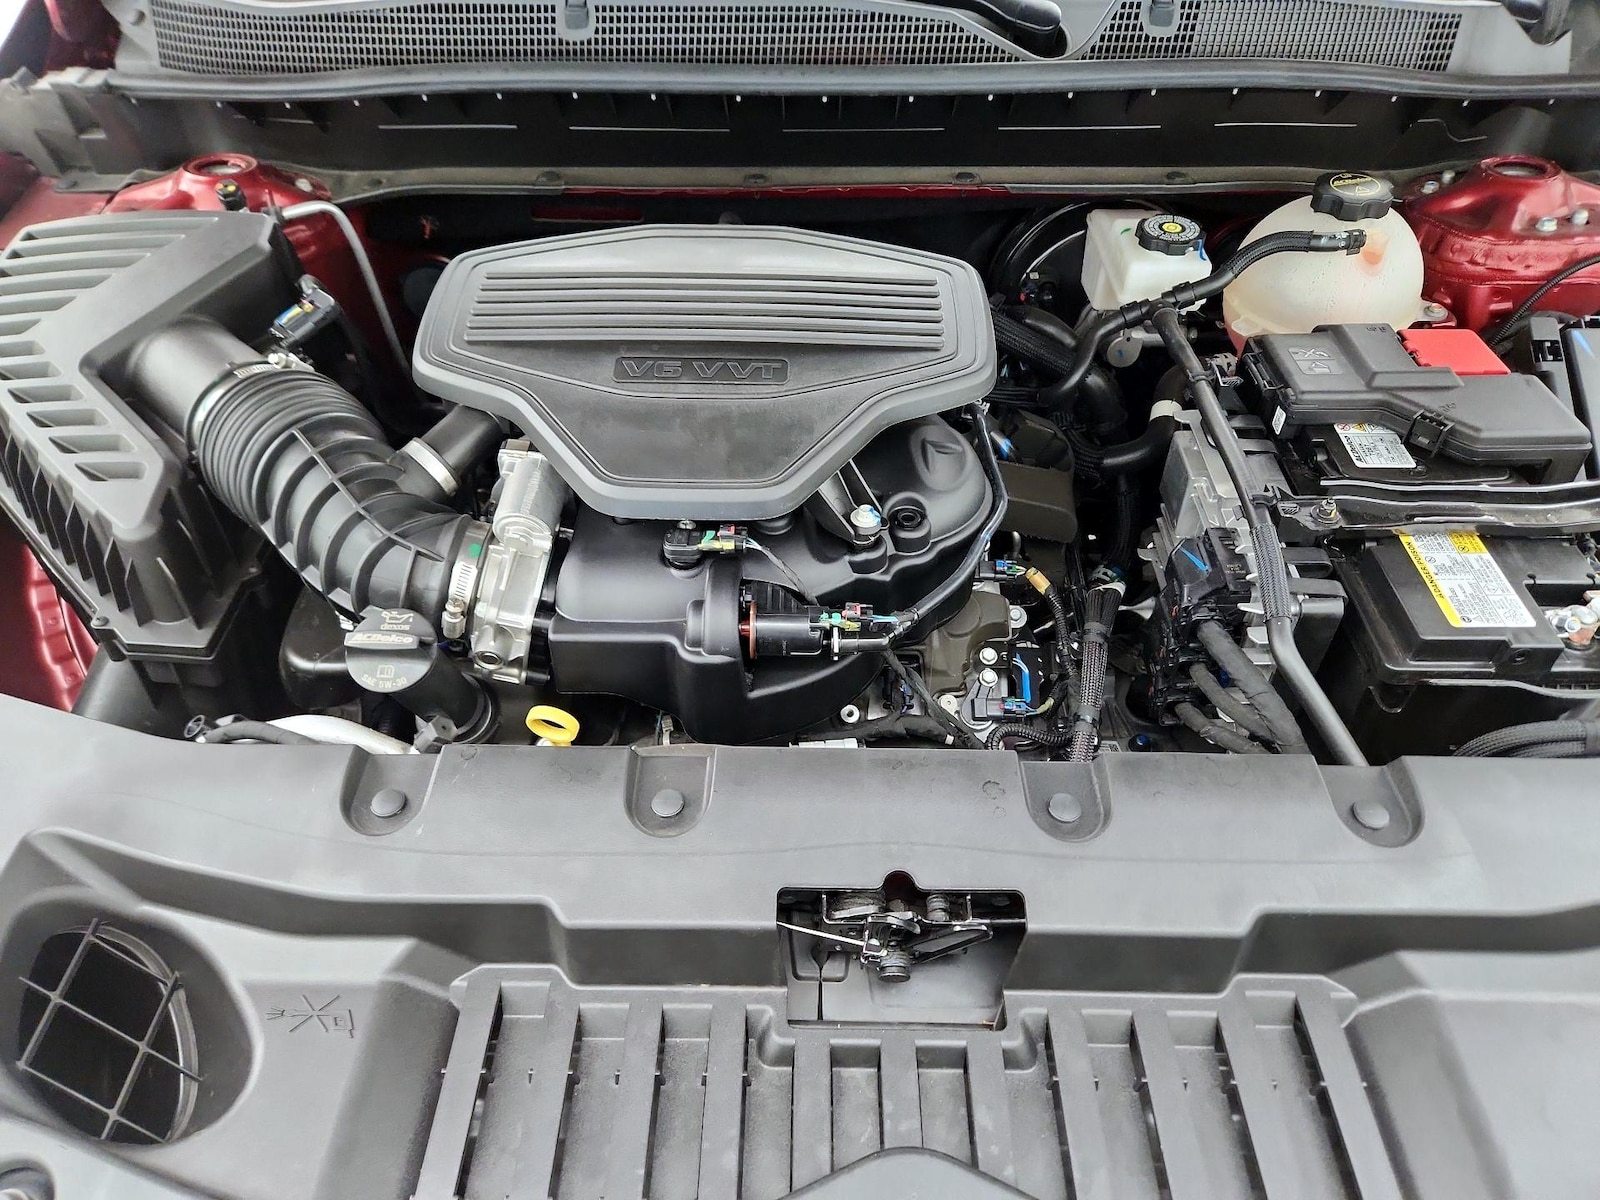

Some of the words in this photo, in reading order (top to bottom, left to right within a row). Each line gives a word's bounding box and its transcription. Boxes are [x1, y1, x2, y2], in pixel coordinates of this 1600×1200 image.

[621, 360, 683, 378] V6
[692, 361, 783, 379] VVT
[380, 623, 411, 631] dexos
[349, 632, 413, 644] ACDelco
[361, 673, 377, 687] SAE
[379, 676, 407, 688] 5W-30
